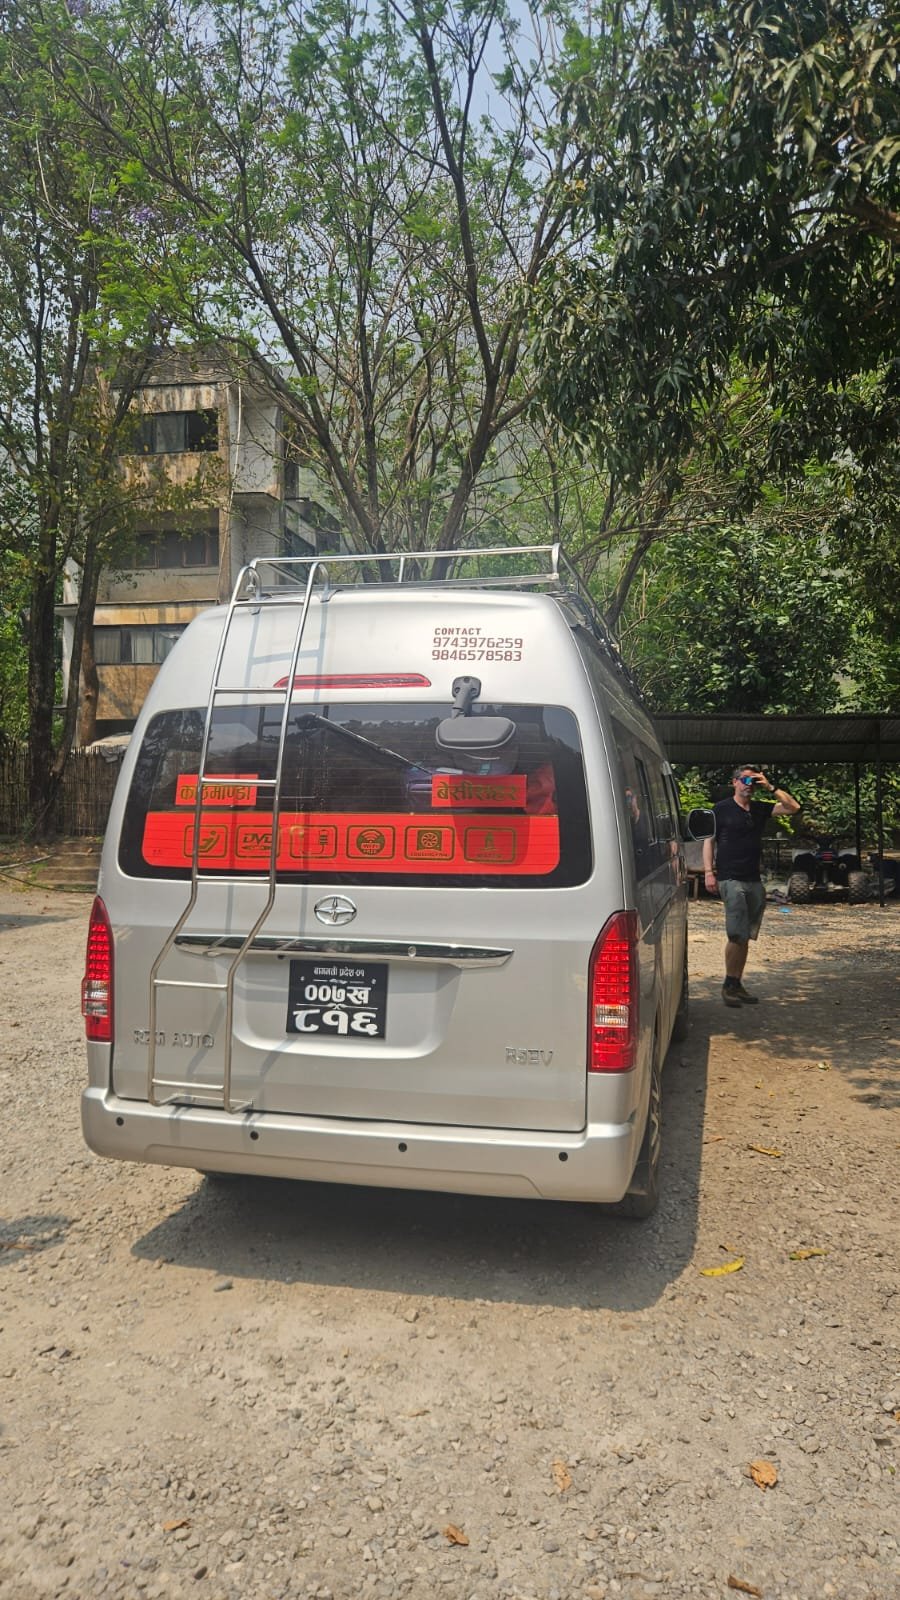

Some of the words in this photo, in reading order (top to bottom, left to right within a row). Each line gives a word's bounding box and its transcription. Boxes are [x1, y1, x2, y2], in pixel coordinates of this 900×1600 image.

[434, 627, 482, 636] CONTACT
[432, 636, 524, 649] 9743976259
[431, 649, 523, 662] 9846578583
[293, 1009, 379, 1036] ८१६
[172, 1031, 215, 1049] AUTO
